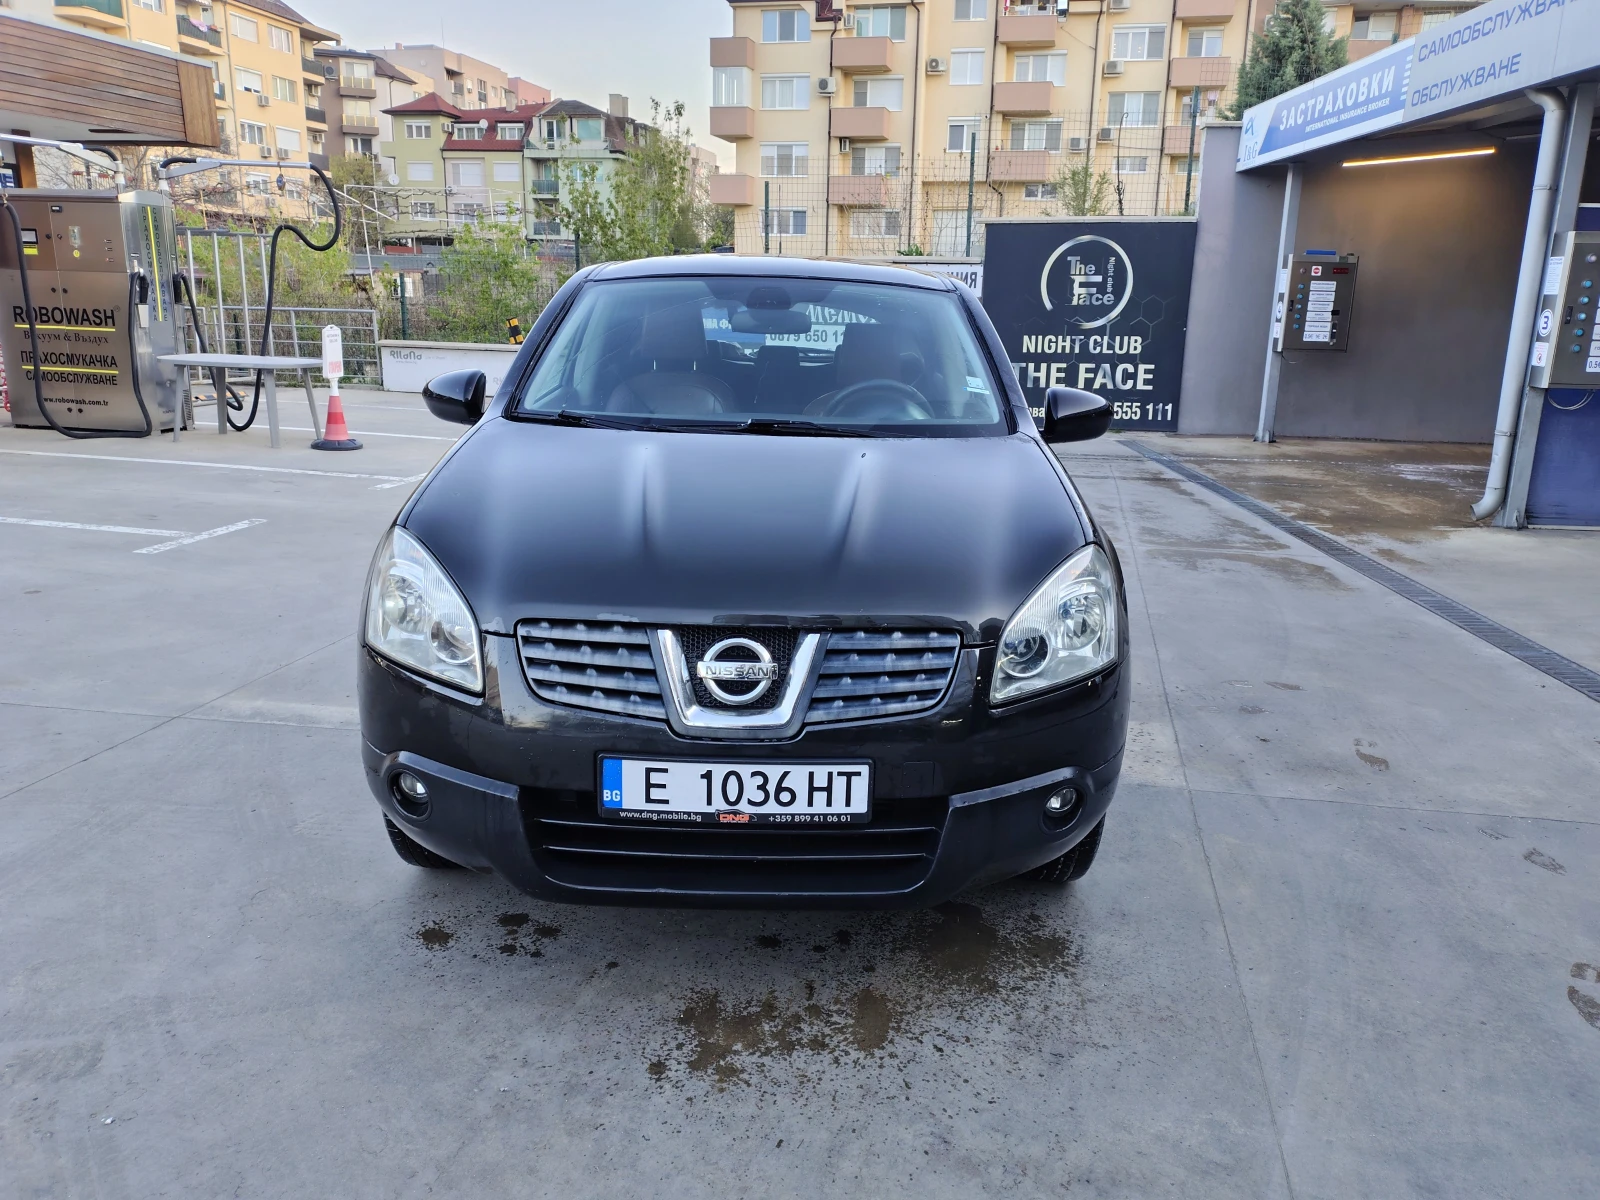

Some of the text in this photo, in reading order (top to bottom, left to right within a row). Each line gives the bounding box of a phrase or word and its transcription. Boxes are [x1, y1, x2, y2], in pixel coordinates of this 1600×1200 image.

[1411, 53, 1522, 108] ОБСЛУЖВАНЕ
[1279, 65, 1396, 131] ЗАСТРАХОВКИ
[1304, 97, 1390, 133] INTERNATIONAL INSURANCE BROKER
[1067, 256, 1096, 275] The
[1106, 277, 1114, 293] club
[1542, 315, 1550, 331] 3
[23, 330, 109, 346] Вкуум & Въздух
[804, 329, 828, 343] 650
[1022, 335, 1143, 355] NIGHT CLUB
[1012, 362, 1067, 388] THE
[1078, 363, 1156, 390] FACE
[1113, 402, 1173, 421] 555 111
[705, 664, 769, 678] NISSAN
[603, 789, 621, 802] BG
[644, 766, 862, 808] E 1036 HT
[619, 810, 702, 822] www.dng.mobile.bg
[768, 814, 792, 822] +359
